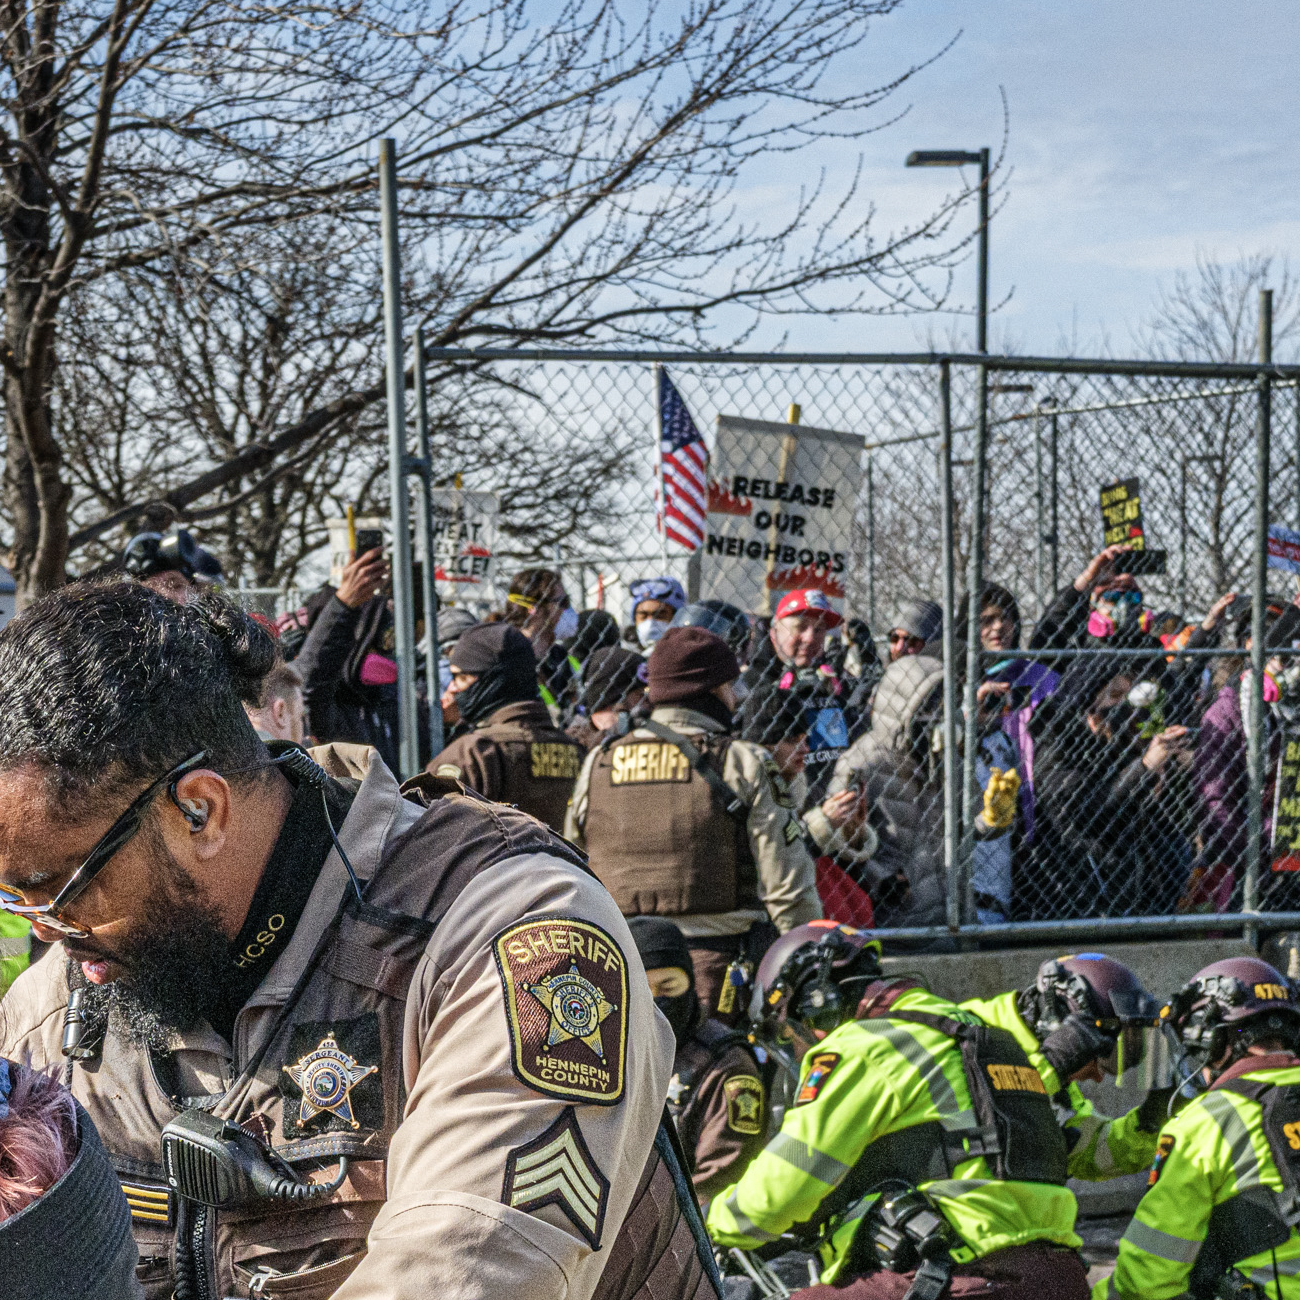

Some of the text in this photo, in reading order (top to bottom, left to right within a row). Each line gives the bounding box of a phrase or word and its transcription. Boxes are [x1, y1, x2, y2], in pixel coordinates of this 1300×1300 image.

[732, 476, 836, 509] RELEASE
[754, 511, 806, 537] OUR
[707, 535, 845, 573] NEIGHBORS
[611, 743, 689, 784] SHERIFF
[233, 914, 285, 968] HCSO
[508, 930, 620, 972] SHERIFF
[304, 1050, 350, 1065] SERGEANT
[536, 1055, 610, 1083] HENNEPIN
[541, 1068, 608, 1092] COUNTY
